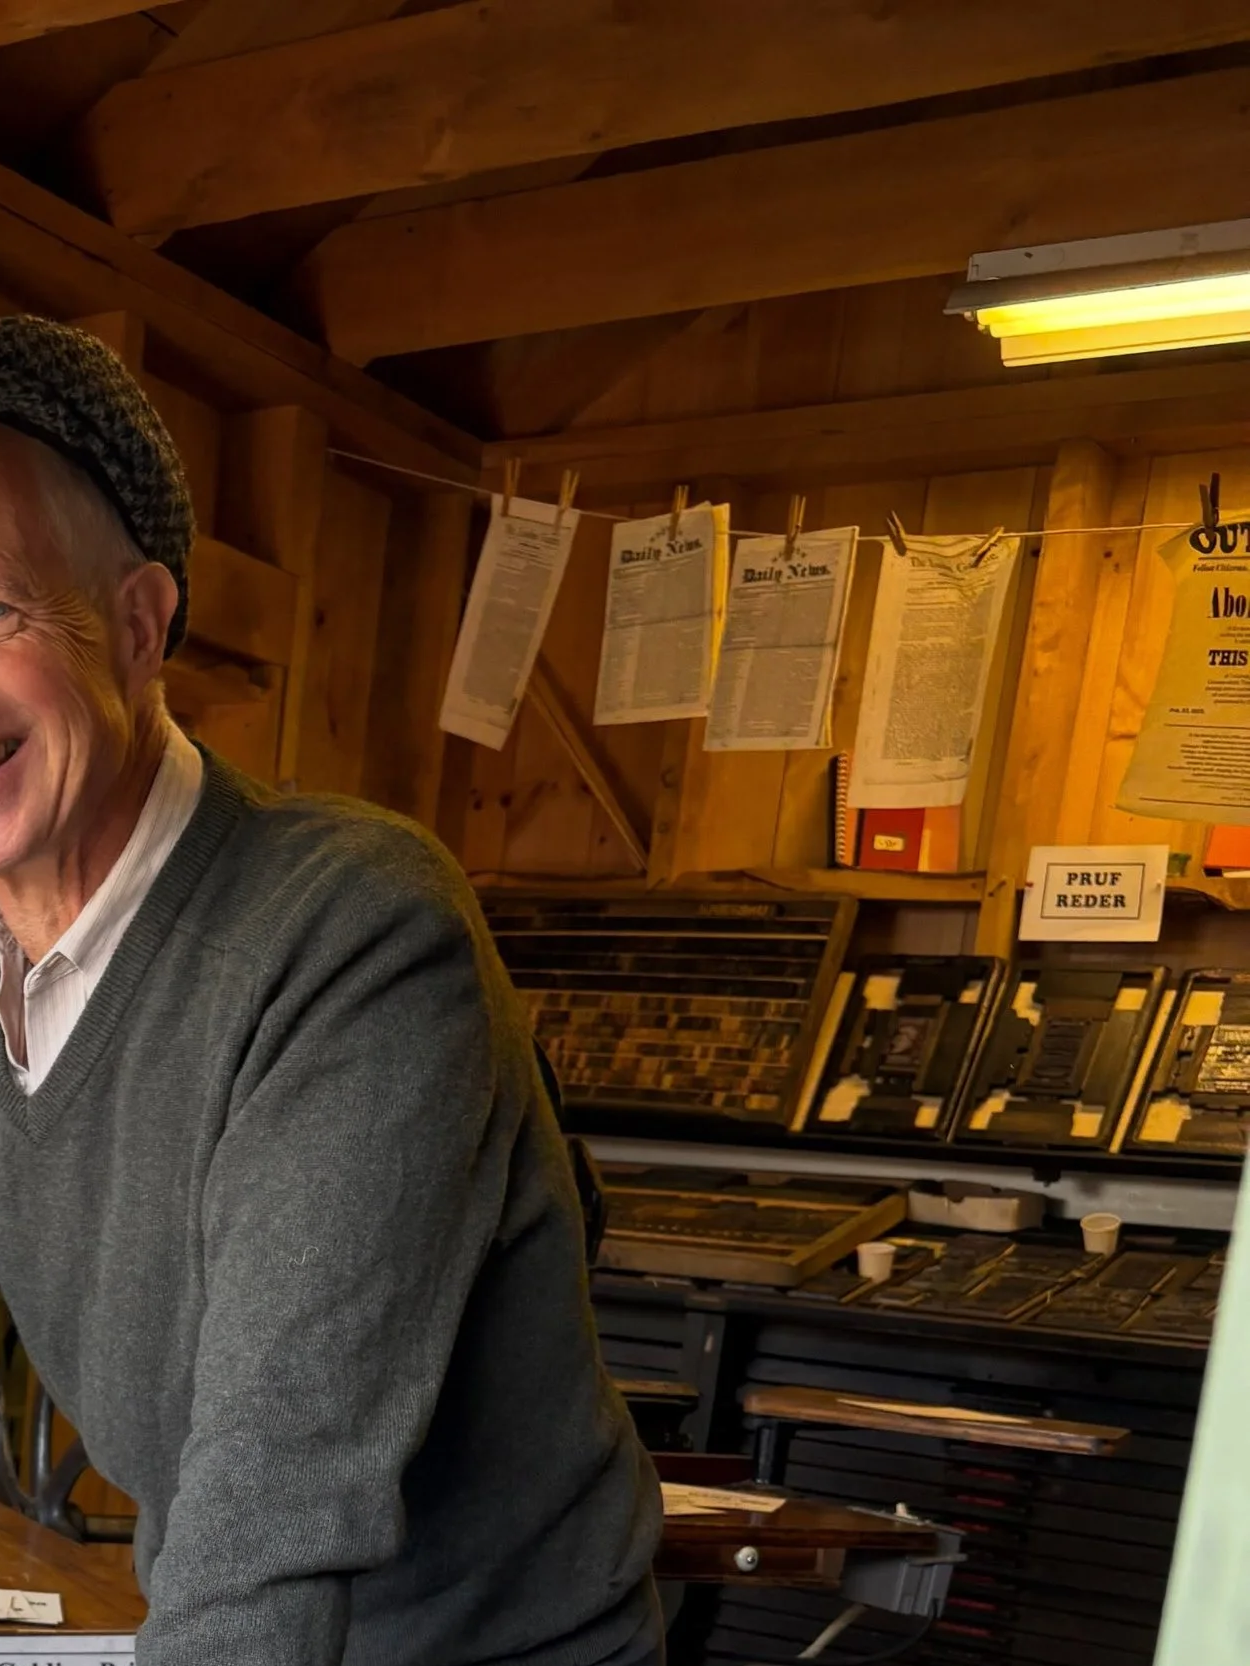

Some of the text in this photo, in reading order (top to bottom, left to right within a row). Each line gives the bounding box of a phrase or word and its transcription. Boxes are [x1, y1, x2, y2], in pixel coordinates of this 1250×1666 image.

[620, 546, 663, 565] Daily
[741, 567, 784, 585] Daily
[1207, 586, 1250, 619] Abo
[1208, 649, 1249, 667] THIS
[1066, 872, 1122, 887] PRUF
[1055, 894, 1127, 909] REDER
